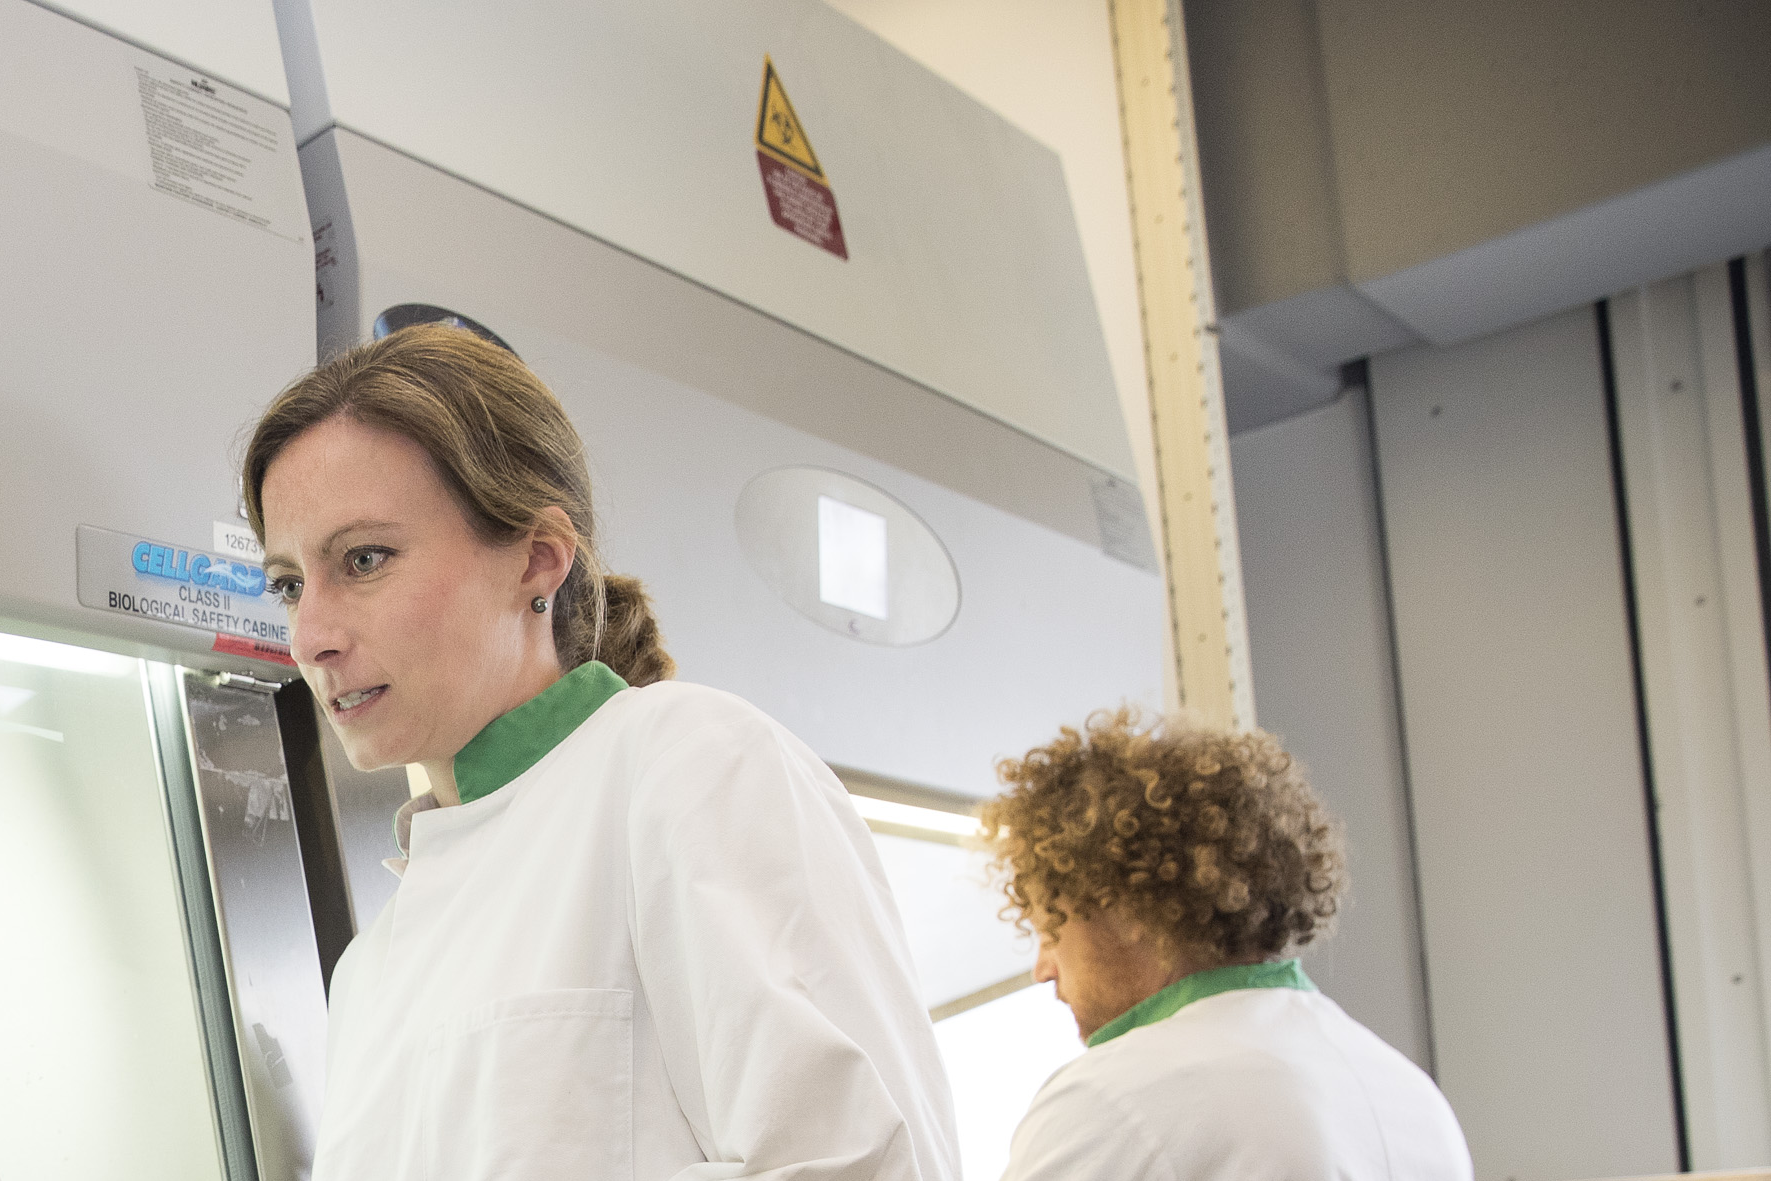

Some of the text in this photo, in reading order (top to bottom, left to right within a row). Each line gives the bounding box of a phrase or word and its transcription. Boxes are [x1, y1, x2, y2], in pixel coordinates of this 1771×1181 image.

[108, 591, 291, 642] BIOLOGICAL SAFETY CABINE
[179, 585, 230, 610] CLASS II
